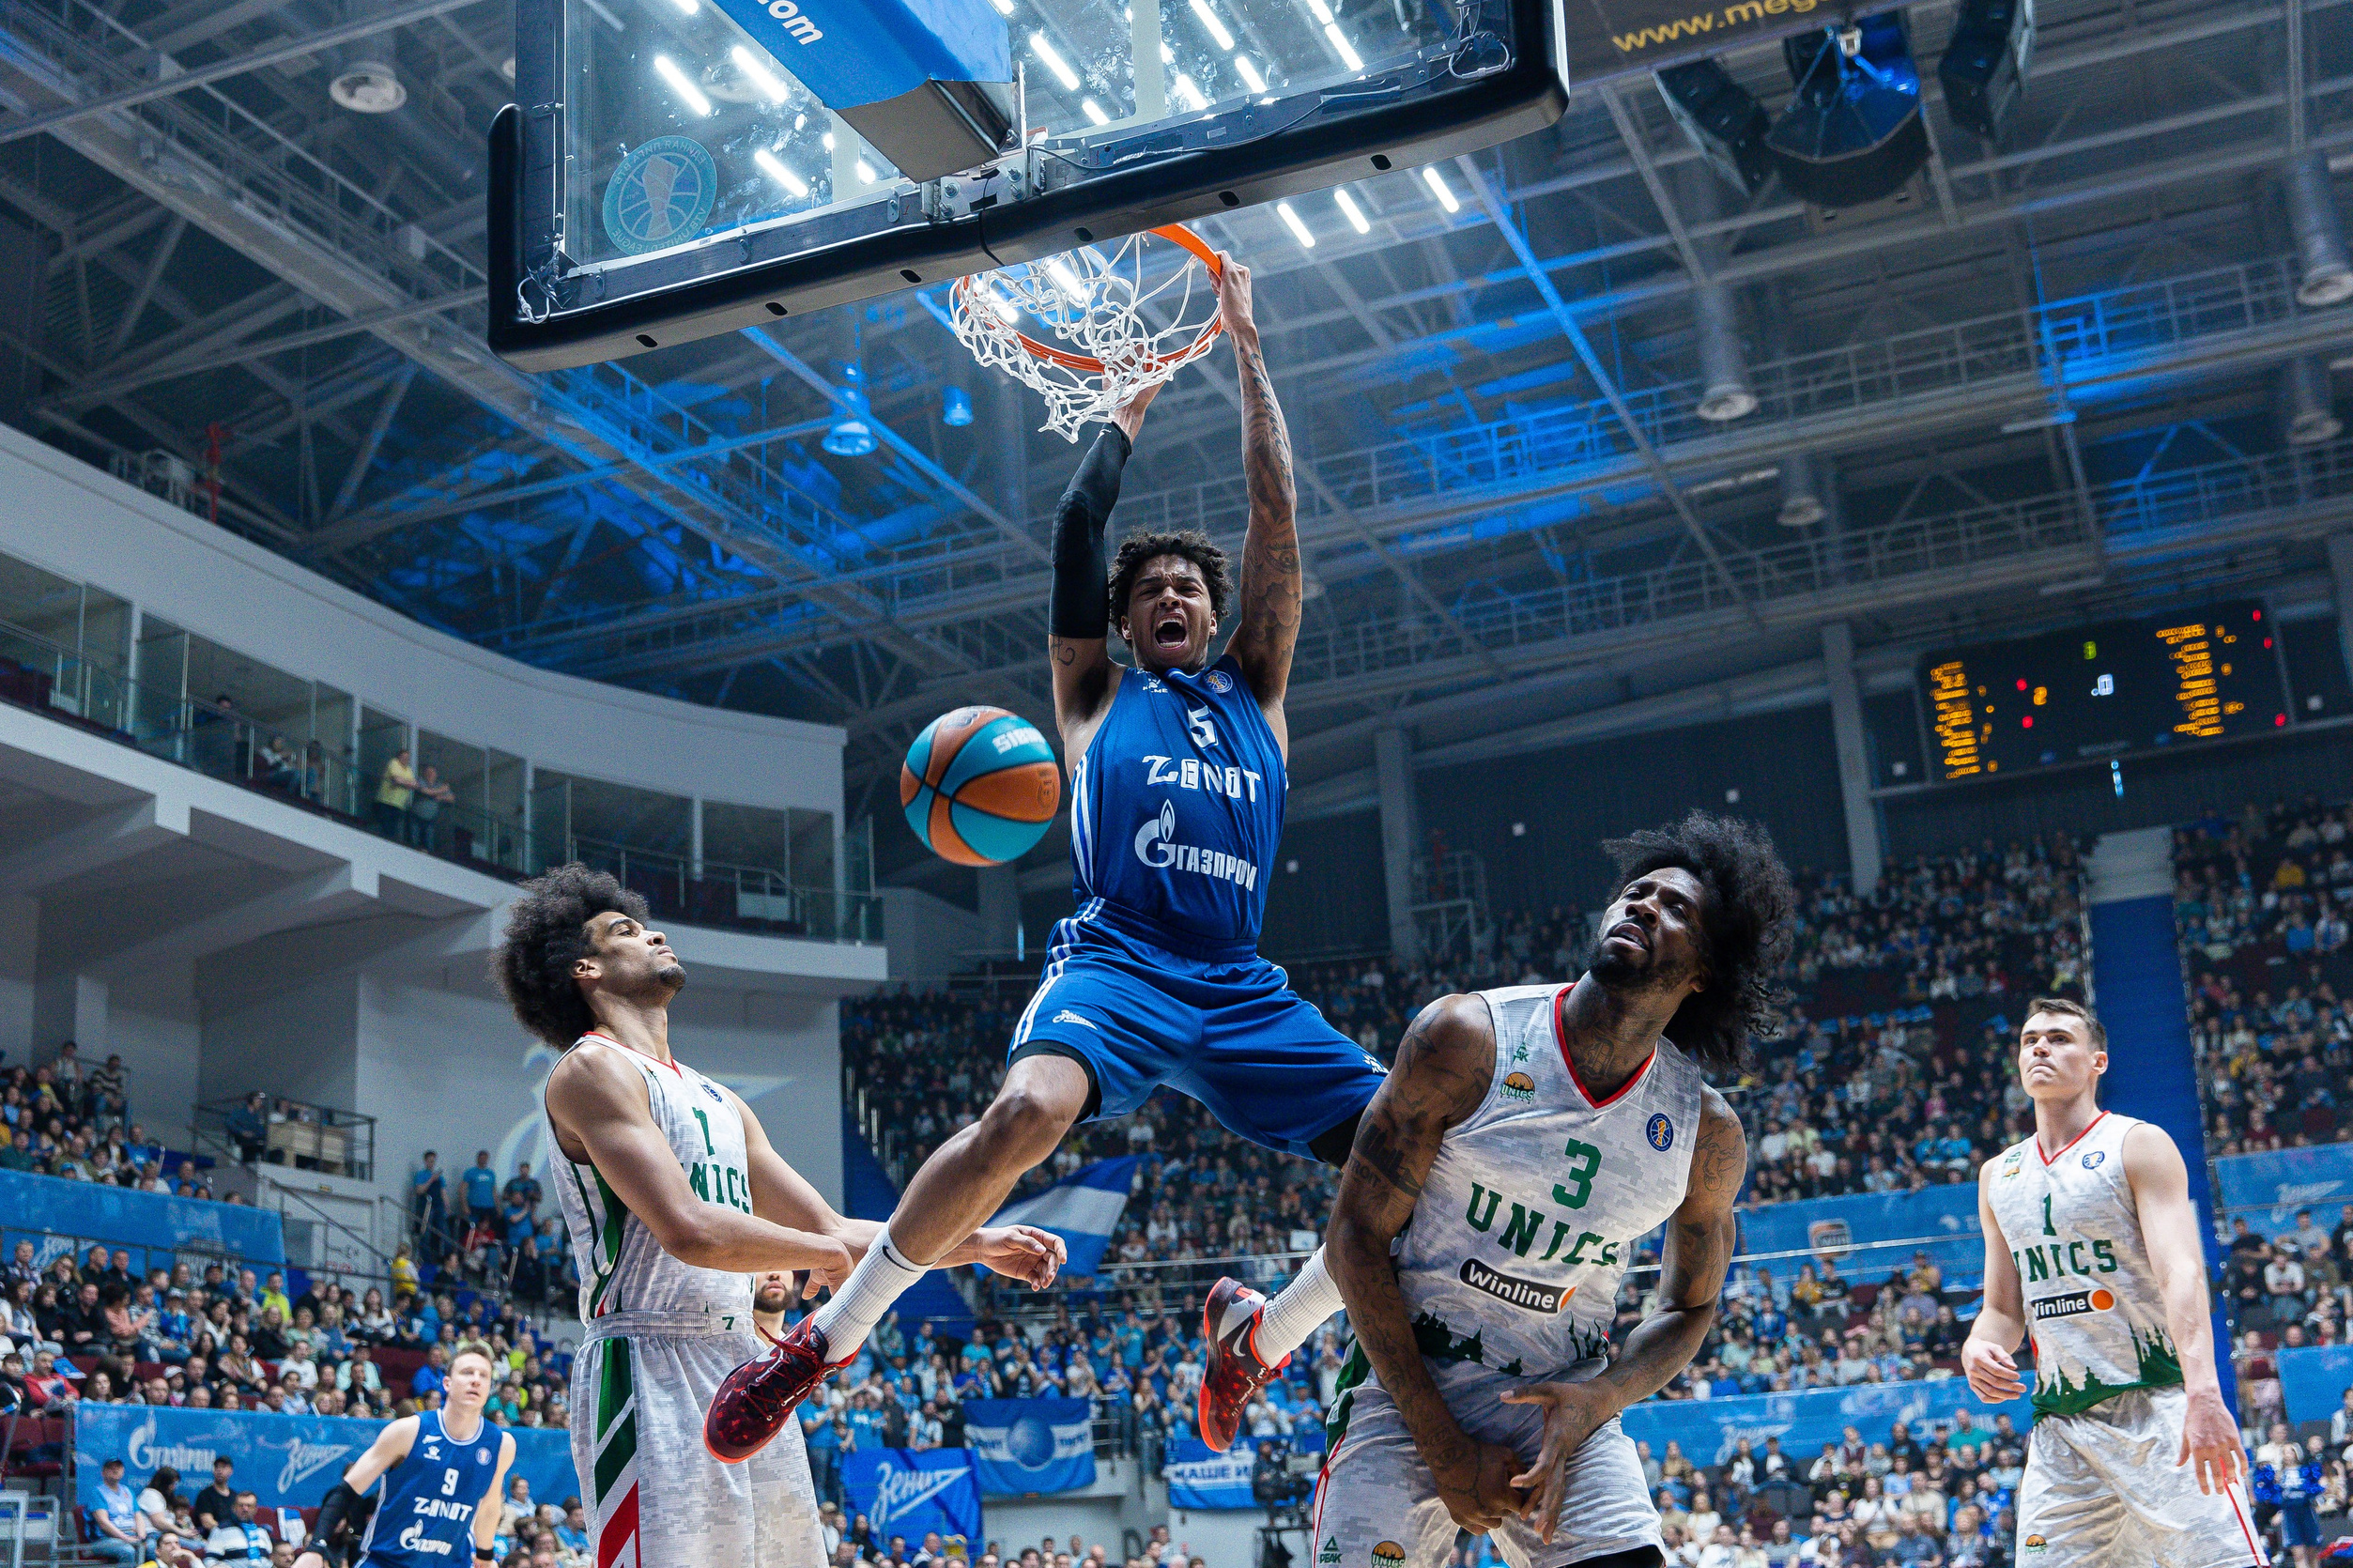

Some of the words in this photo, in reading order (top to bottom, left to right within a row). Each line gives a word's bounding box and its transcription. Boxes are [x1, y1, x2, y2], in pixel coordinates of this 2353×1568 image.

[1188, 705, 1219, 750] 5
[1142, 755, 1262, 804] ZENIT
[1499, 1084, 1535, 1101] UNICS
[680, 1162, 750, 1215] NICS
[1551, 1137, 1603, 1210] 3
[1465, 1181, 1621, 1267] UNICS
[2042, 1191, 2057, 1237] 1
[1468, 1263, 1556, 1310] Winline
[722, 1316, 734, 1330] 7
[440, 1468, 460, 1497] 9
[1319, 1553, 1343, 1564] PEAK
